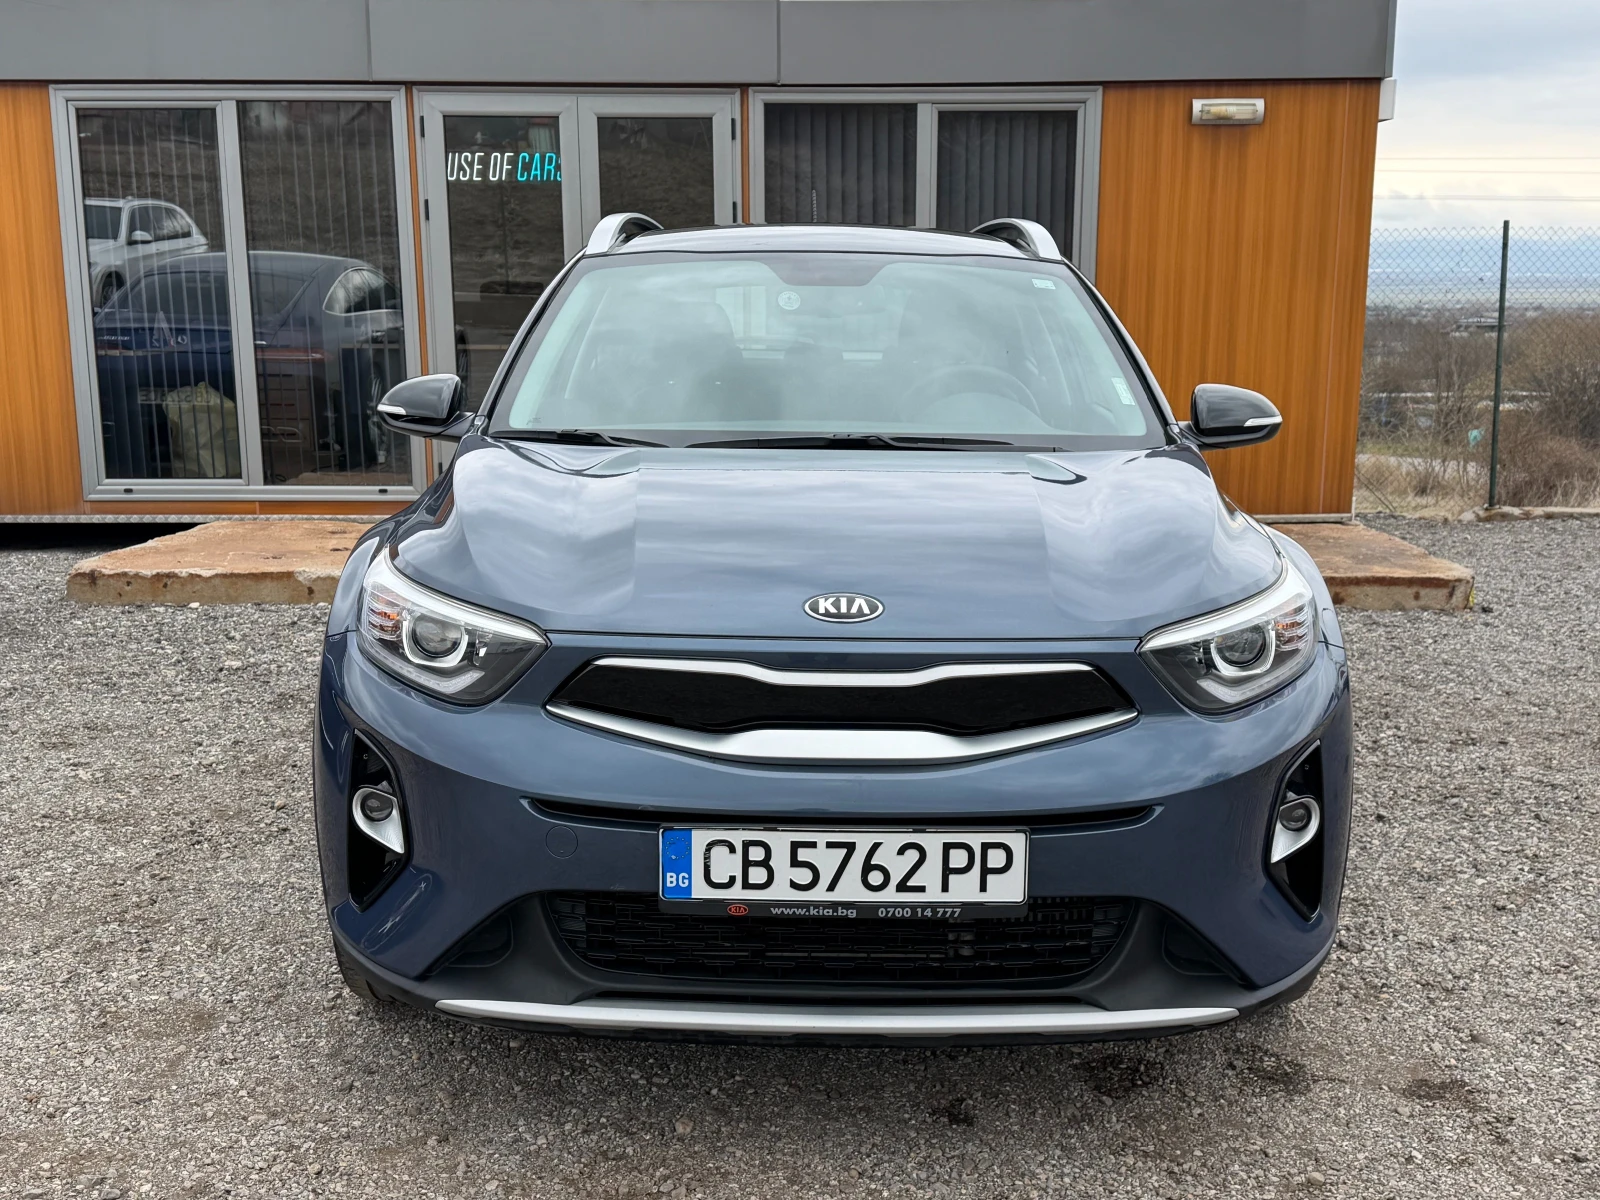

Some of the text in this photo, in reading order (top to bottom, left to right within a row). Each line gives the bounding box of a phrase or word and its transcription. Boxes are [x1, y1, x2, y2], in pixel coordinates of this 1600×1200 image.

[447, 152, 485, 181] USE
[489, 152, 515, 181] OF
[817, 597, 871, 615] KIA
[703, 838, 1014, 893] CB 5762 PP
[666, 872, 689, 888] BG
[770, 906, 857, 918] www.kia.bg
[878, 907, 962, 918] 0700 14 777
